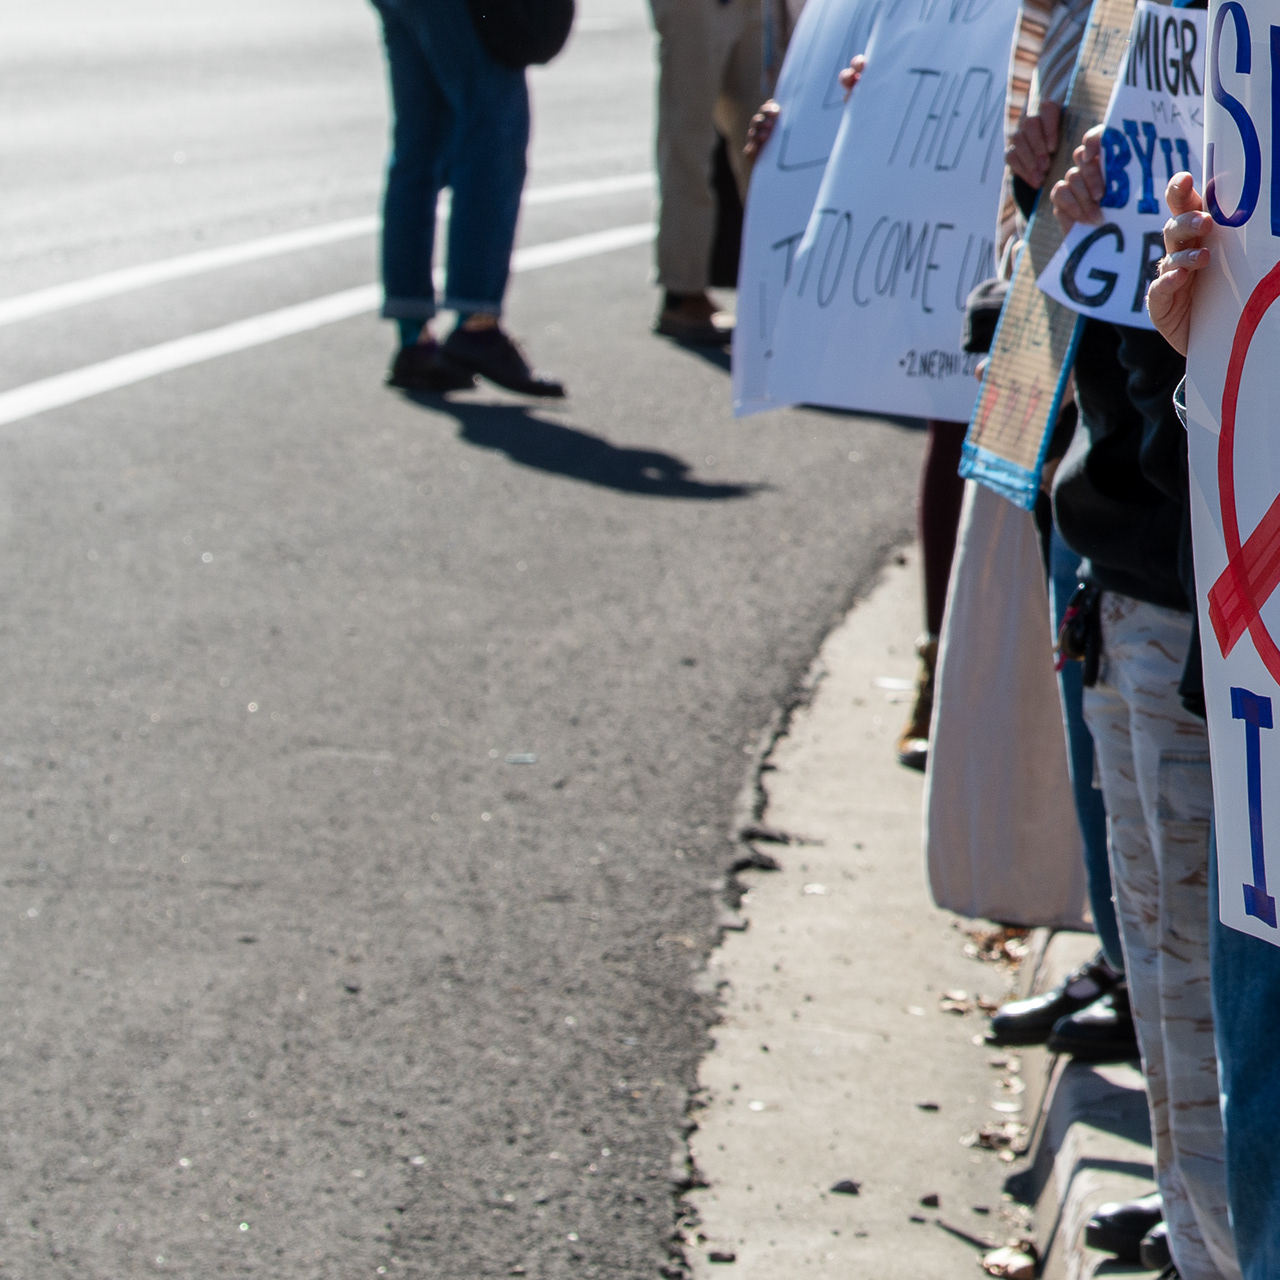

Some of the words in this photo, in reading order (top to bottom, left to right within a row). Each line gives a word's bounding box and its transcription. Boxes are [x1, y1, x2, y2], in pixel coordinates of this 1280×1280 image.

[887, 66, 1007, 184] THEM
[797, 208, 853, 309] TO
[852, 215, 955, 313] COME
